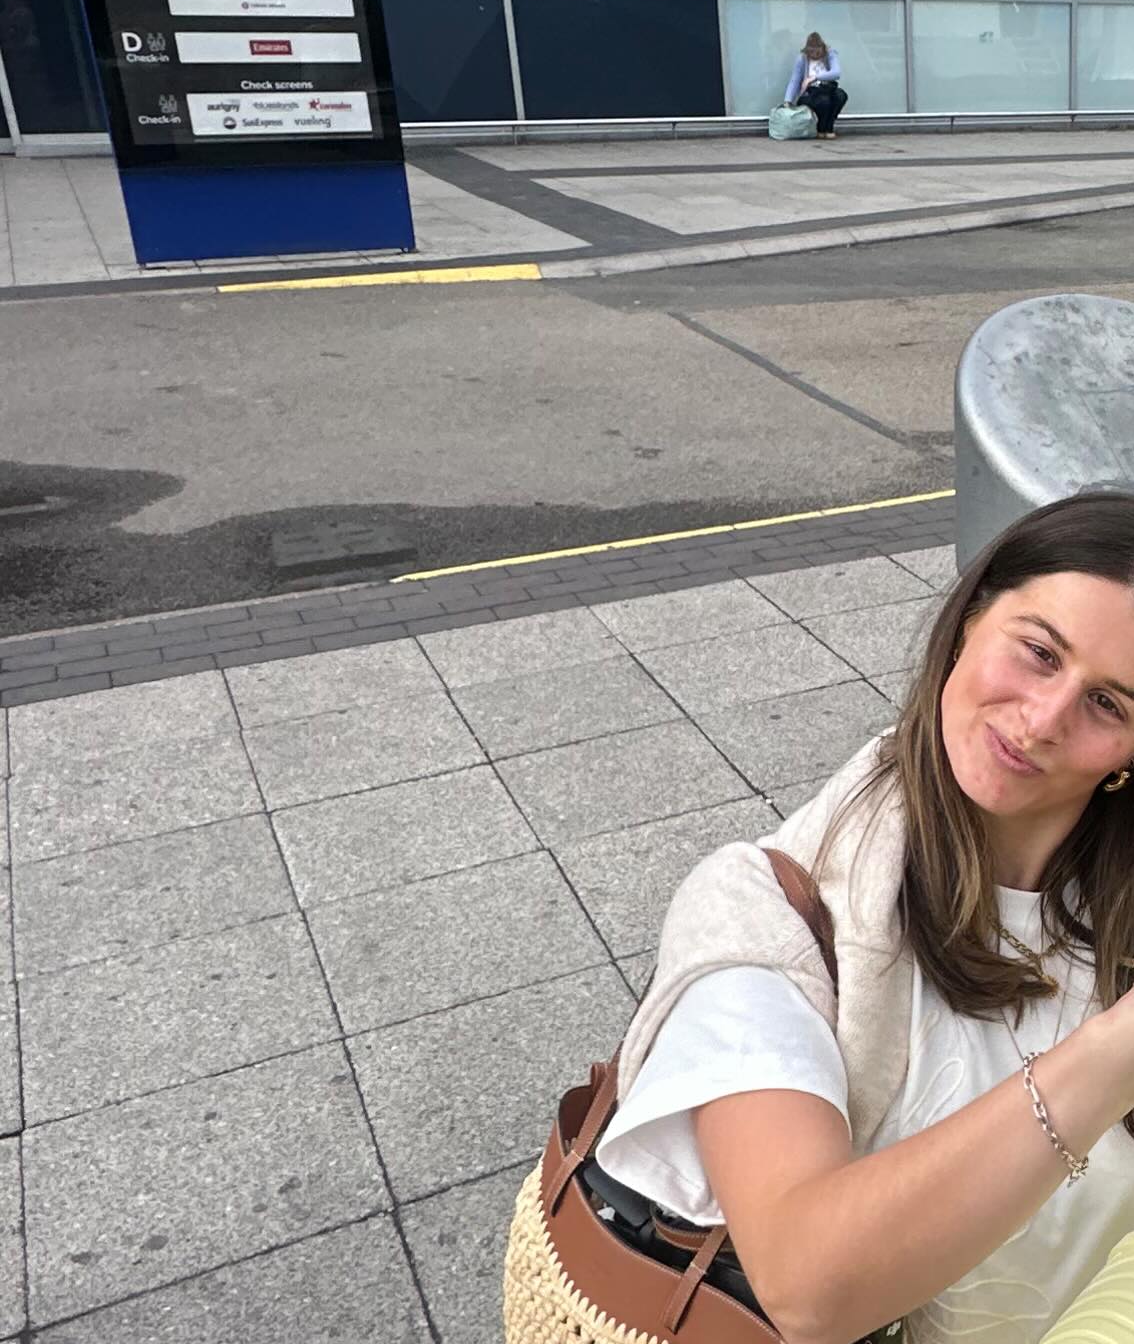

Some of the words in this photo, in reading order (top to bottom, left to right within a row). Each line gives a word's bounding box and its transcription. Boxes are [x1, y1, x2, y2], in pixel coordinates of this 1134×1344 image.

[121, 32, 143, 52] D
[125, 52, 170, 64] Check-in
[240, 80, 273, 90] Check
[274, 81, 314, 90] screens
[138, 114, 182, 126] Check-in
